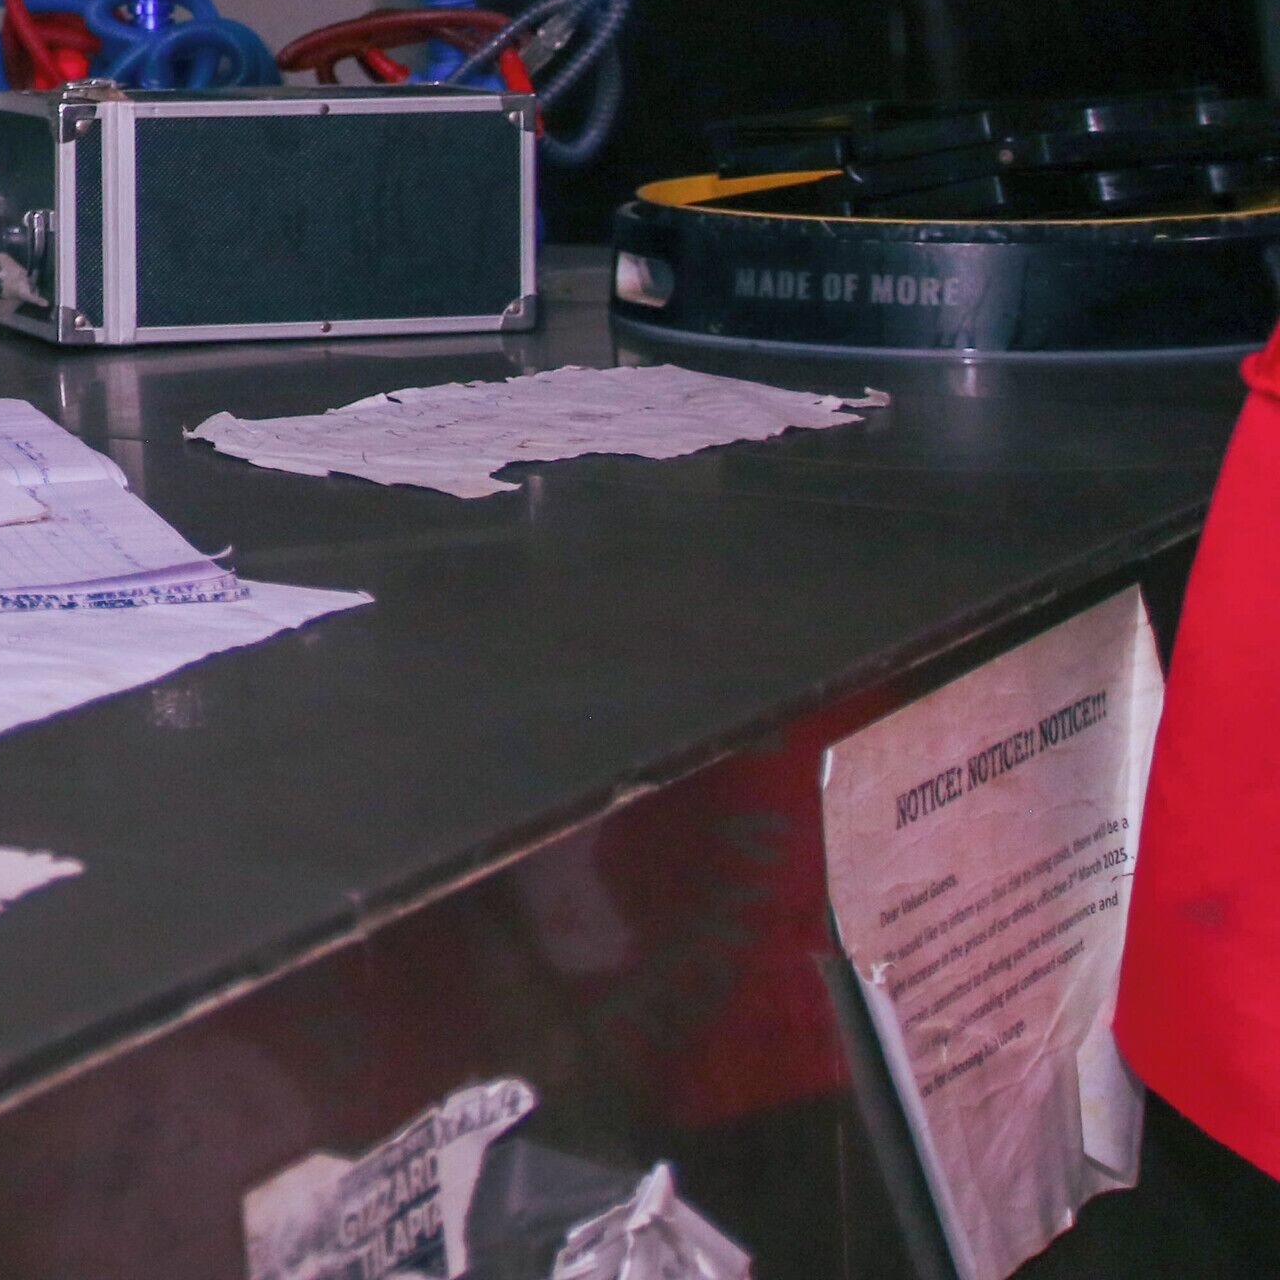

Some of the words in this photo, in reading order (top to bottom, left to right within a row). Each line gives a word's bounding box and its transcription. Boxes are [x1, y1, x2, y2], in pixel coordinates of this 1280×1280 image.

[735, 270, 811, 301] MADE
[821, 272, 861, 303] OF
[871, 274, 963, 306] MORE
[895, 765, 964, 831] NOTICE!
[967, 727, 1036, 792] NOTICE!!
[1038, 689, 1108, 753] NOTICE!!!
[1106, 818, 1118, 834] be
[1122, 815, 1129, 830] a
[1078, 858, 1101, 881] March
[880, 907, 899, 927] Dear
[901, 888, 927, 914] Valued
[1098, 890, 1118, 912] and
